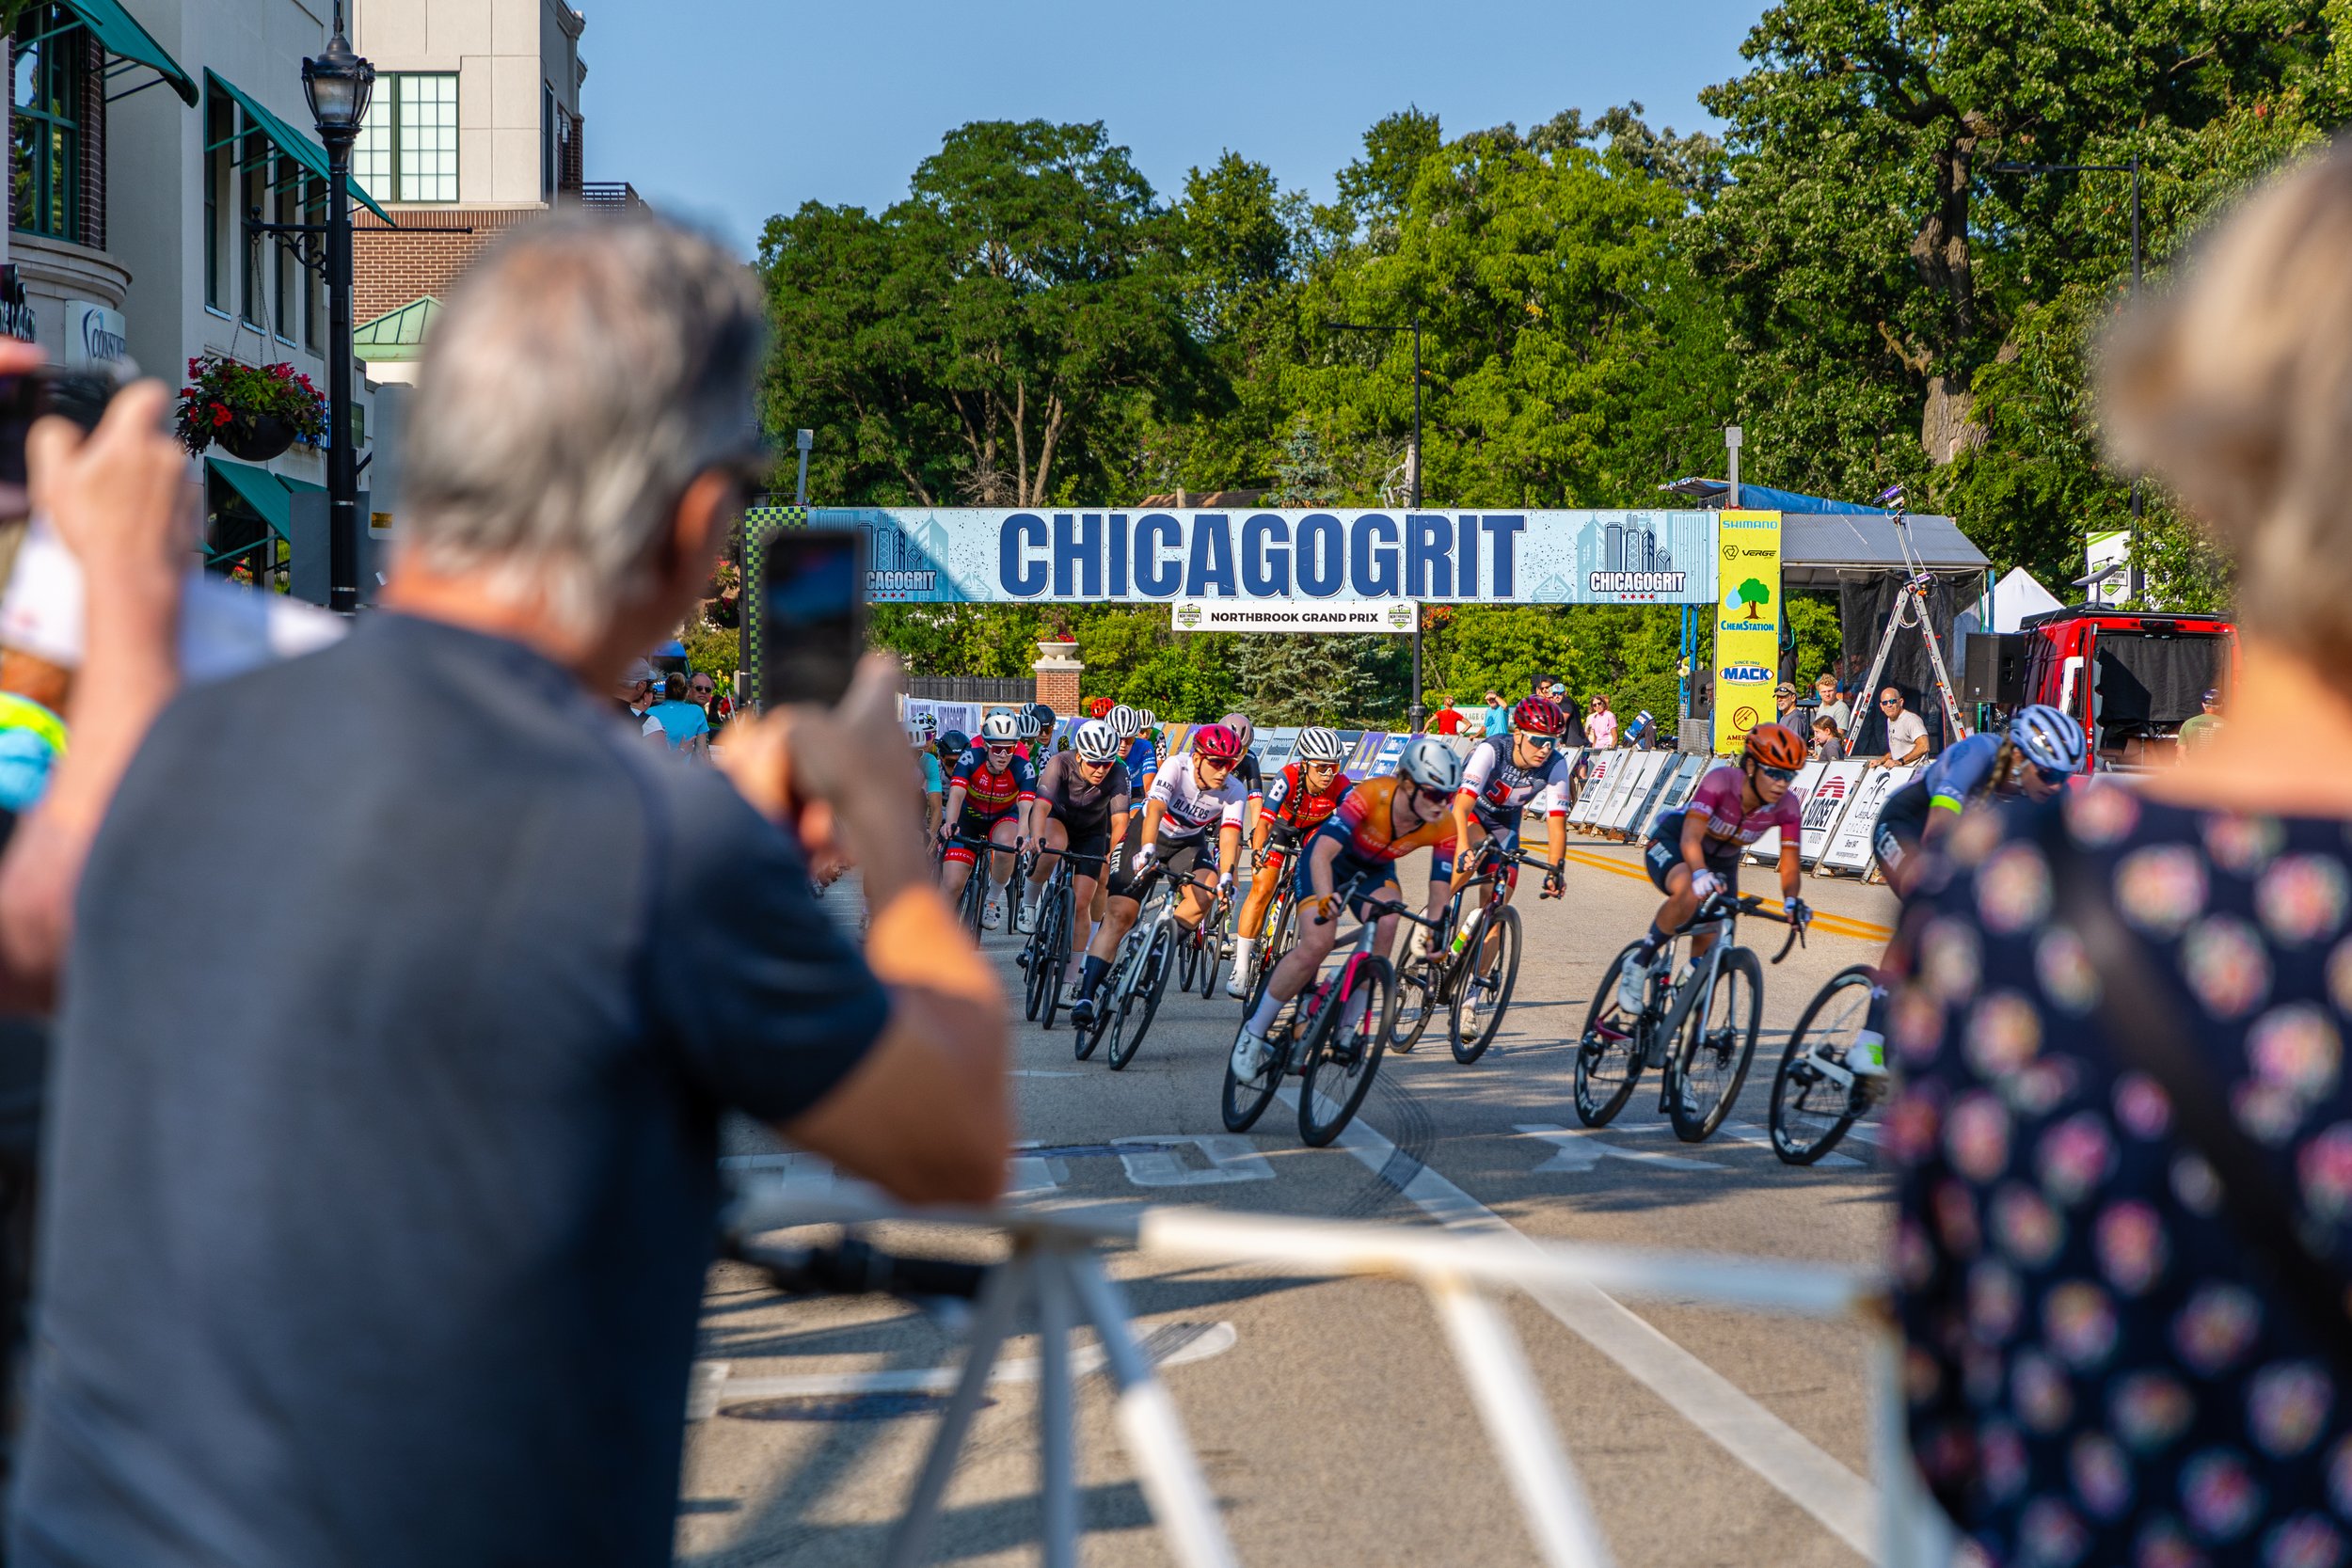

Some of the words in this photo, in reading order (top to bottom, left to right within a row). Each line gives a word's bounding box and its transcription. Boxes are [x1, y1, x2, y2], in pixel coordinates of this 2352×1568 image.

[1723, 520, 1777, 529] SHIMANO
[999, 513, 1527, 599] CHICAGOGRIT
[1590, 572, 1686, 592] CHICAGOGRIT
[1211, 612, 1299, 622] NORTHBROOK
[1302, 612, 1346, 622] GRAND
[1349, 613, 1378, 623] PRIX
[1724, 667, 1770, 680] MACK
[1172, 798, 1210, 820] BLAZERS
